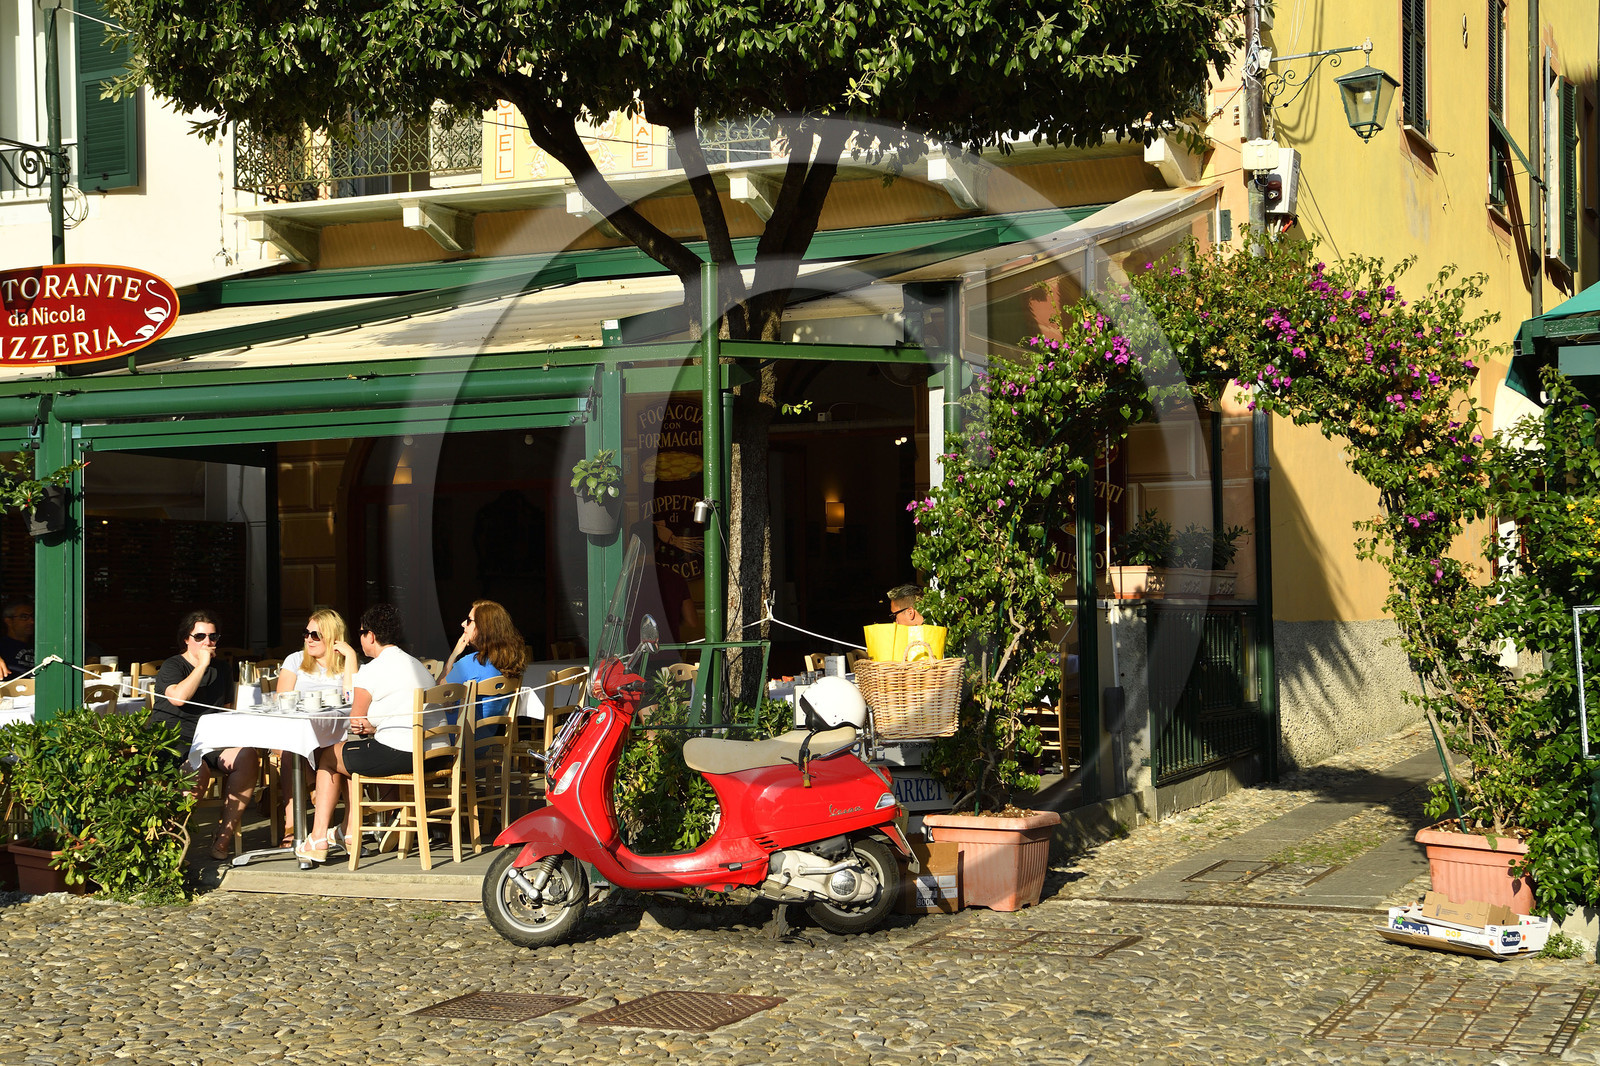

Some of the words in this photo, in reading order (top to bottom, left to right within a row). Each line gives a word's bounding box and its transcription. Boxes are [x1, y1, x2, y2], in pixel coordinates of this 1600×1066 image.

[1, 273, 142, 302] TORANTE
[8, 309, 29, 327] da
[32, 304, 86, 326] Nicola
[638, 430, 703, 449] FORMAGGI
[641, 494, 701, 520] ZUPPETT
[669, 512, 679, 523] di
[895, 778, 943, 803] ARKET
[829, 803, 864, 817] Vespa
[1445, 929, 1462, 939] DOP
